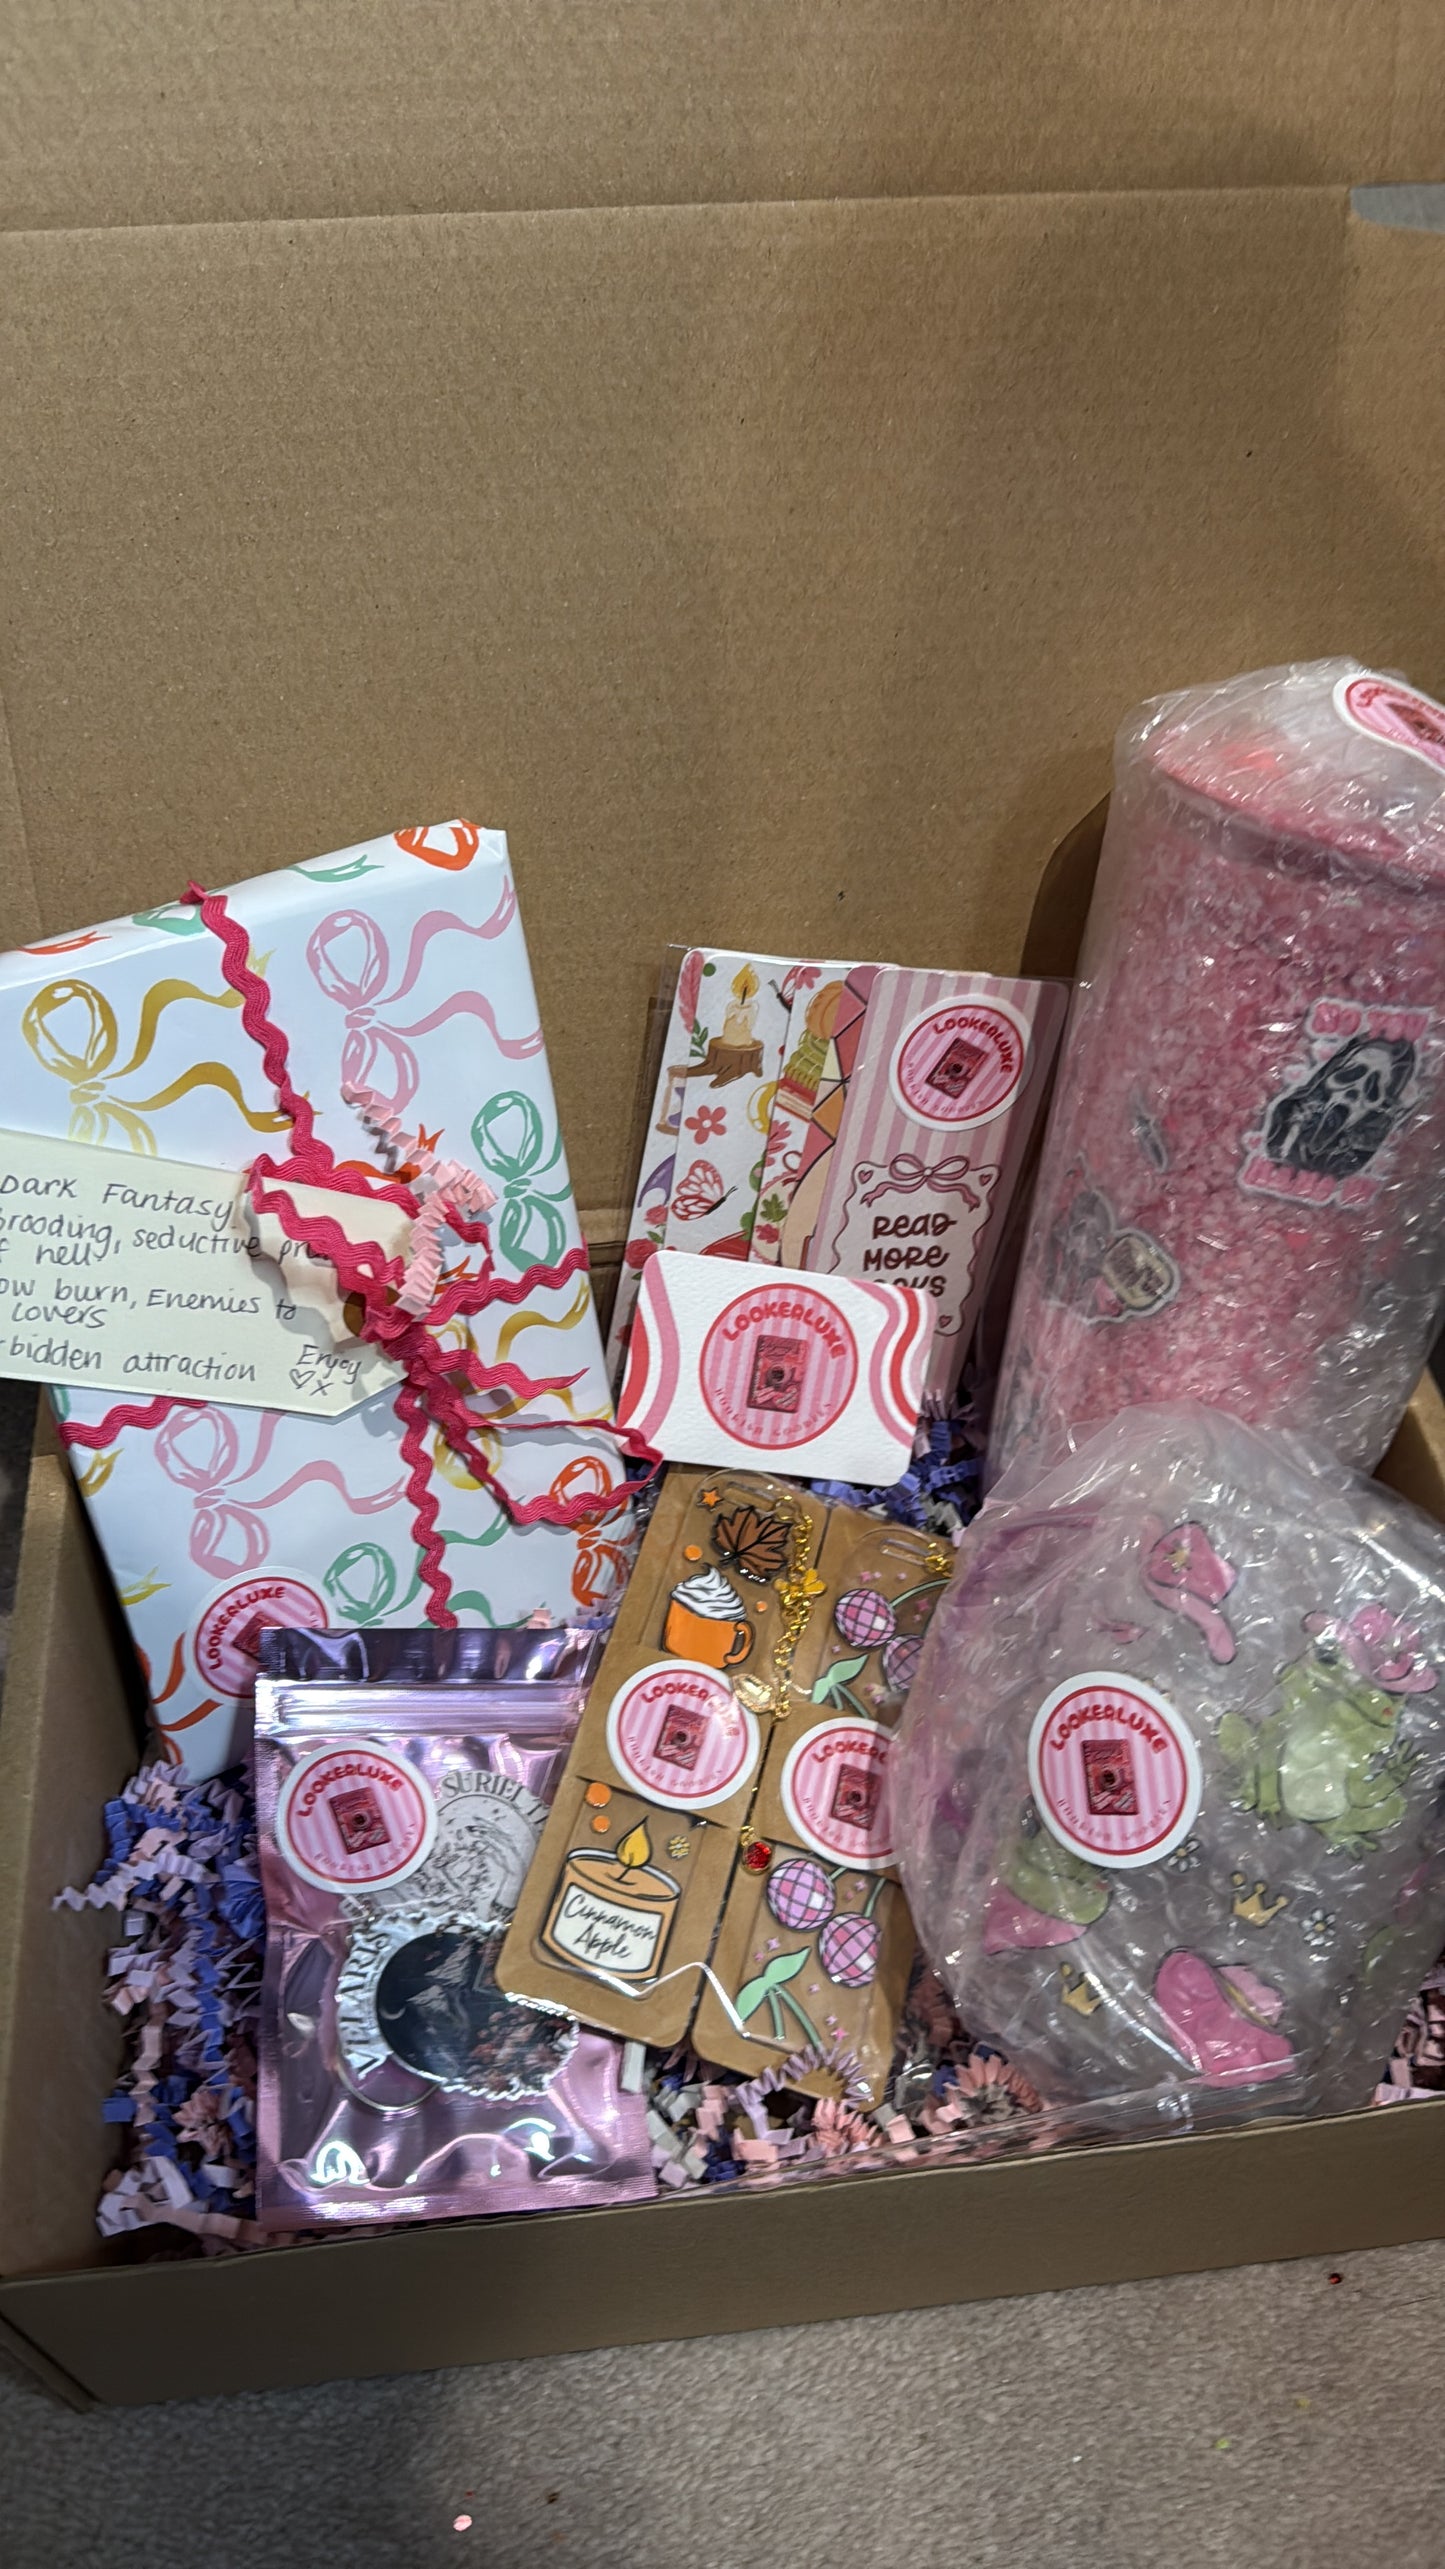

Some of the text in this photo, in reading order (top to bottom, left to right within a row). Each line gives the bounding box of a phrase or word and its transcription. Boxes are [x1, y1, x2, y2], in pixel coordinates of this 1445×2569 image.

[932, 1016, 1014, 1074] LOOKERLUXE
[102, 1182, 234, 1232] Fantasy
[132, 1224, 260, 1258] seductive
[146, 1287, 261, 1315] Enemies
[273, 1298, 297, 1321] to
[722, 1300, 847, 1360] LOOKERLUXE
[122, 1351, 256, 1383] attraction
[297, 1344, 362, 1385] Enjoy
[207, 1585, 286, 1671] LOOKERLUXE
[1050, 1703, 1169, 1755] LOOKERLUXE
[296, 1763, 404, 1818] LOOKERLUXE
[563, 1893, 659, 1941] Cinnamon
[572, 1921, 632, 1960] Apple
[339, 1930, 391, 2074] VELARIS
